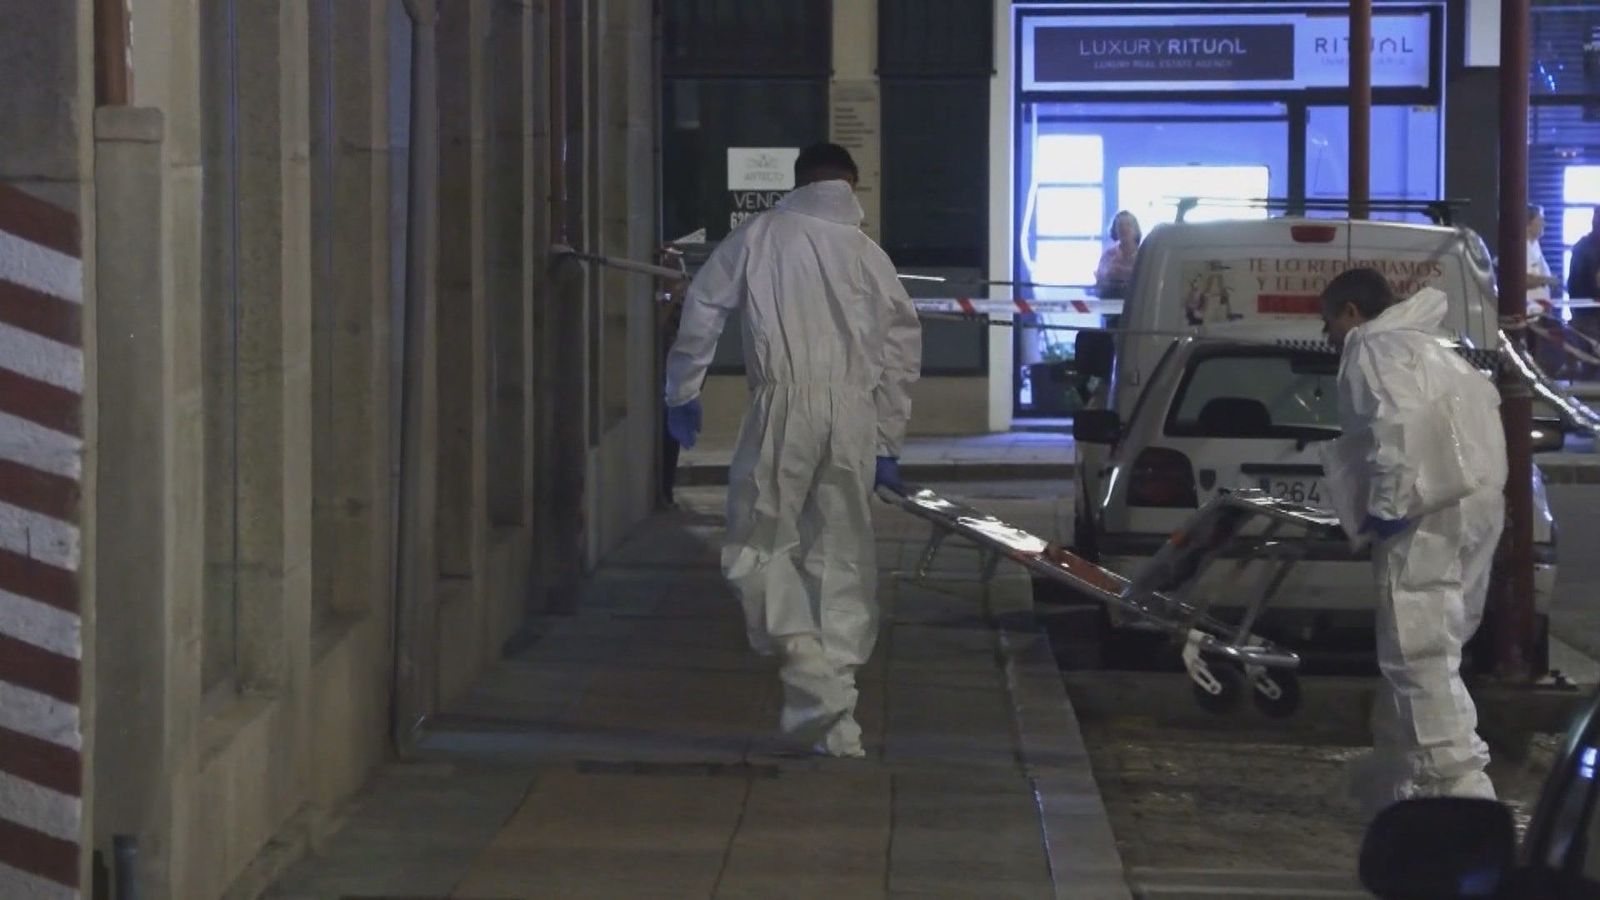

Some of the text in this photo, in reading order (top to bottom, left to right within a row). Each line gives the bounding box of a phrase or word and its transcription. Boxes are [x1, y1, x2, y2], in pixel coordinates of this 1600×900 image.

[1314, 36, 1414, 54] RIAL
[1132, 59, 1156, 69] REAL
[1158, 58, 1193, 68] ESTATE
[1195, 57, 1233, 68] AGENCY
[1249, 257, 1267, 273] TE
[1276, 257, 1300, 273] LO
